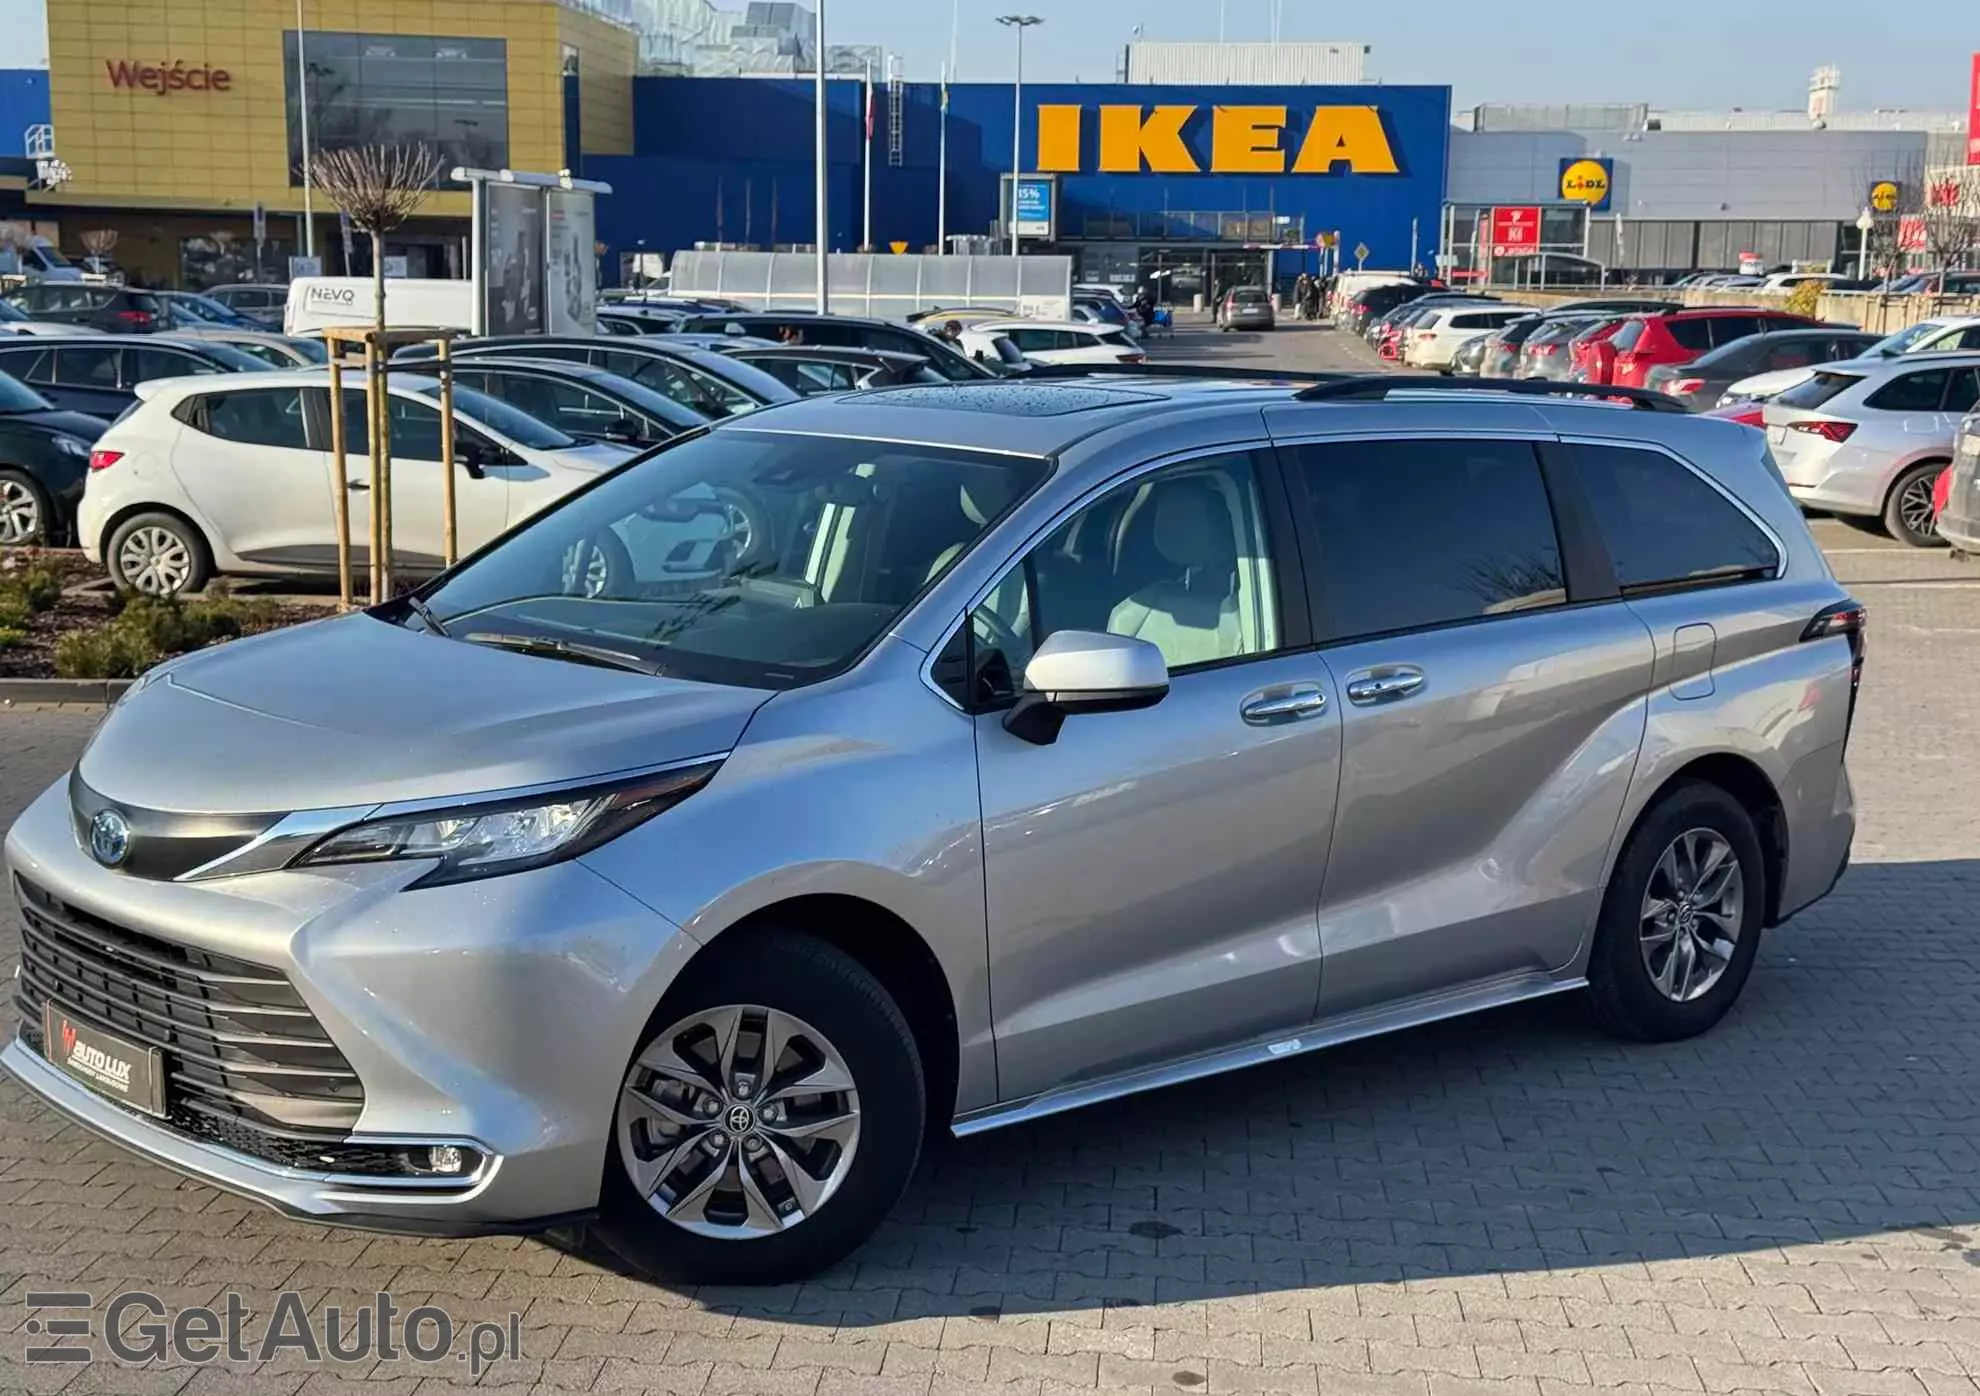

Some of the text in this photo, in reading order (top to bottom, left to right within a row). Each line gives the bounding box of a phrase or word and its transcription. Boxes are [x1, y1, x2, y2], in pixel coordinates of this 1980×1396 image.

[105, 58, 231, 96] Wejście
[1037, 104, 1399, 174] IKEA
[73, 1040, 105, 1069] AUTO
[105, 1055, 131, 1080] LUX
